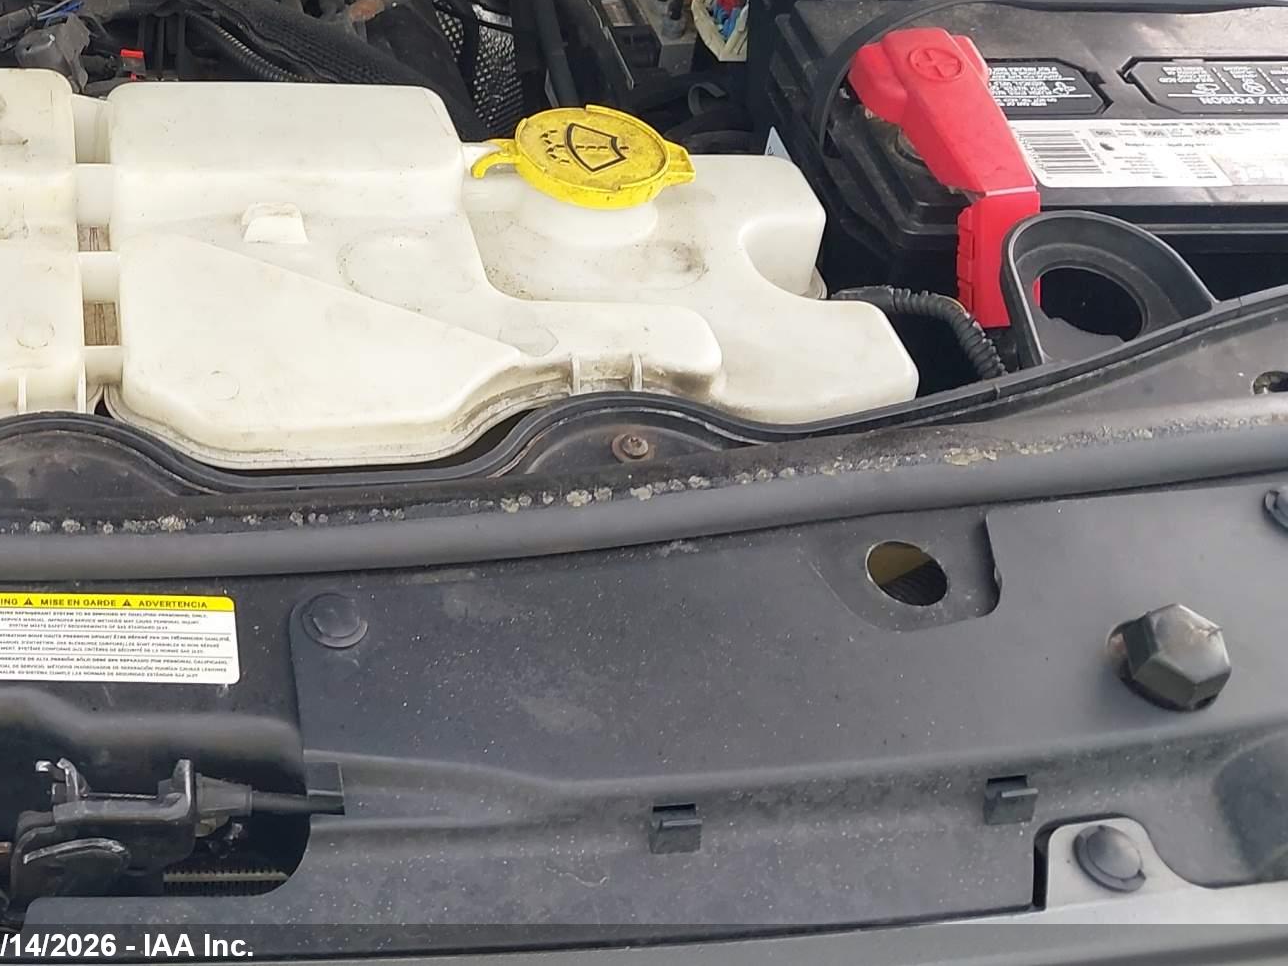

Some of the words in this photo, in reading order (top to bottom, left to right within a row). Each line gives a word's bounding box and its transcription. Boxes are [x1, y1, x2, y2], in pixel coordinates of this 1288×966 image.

[40, 598, 65, 606] MISE
[83, 599, 117, 607] GARDE
[138, 600, 208, 608] ADVERTENCIA
